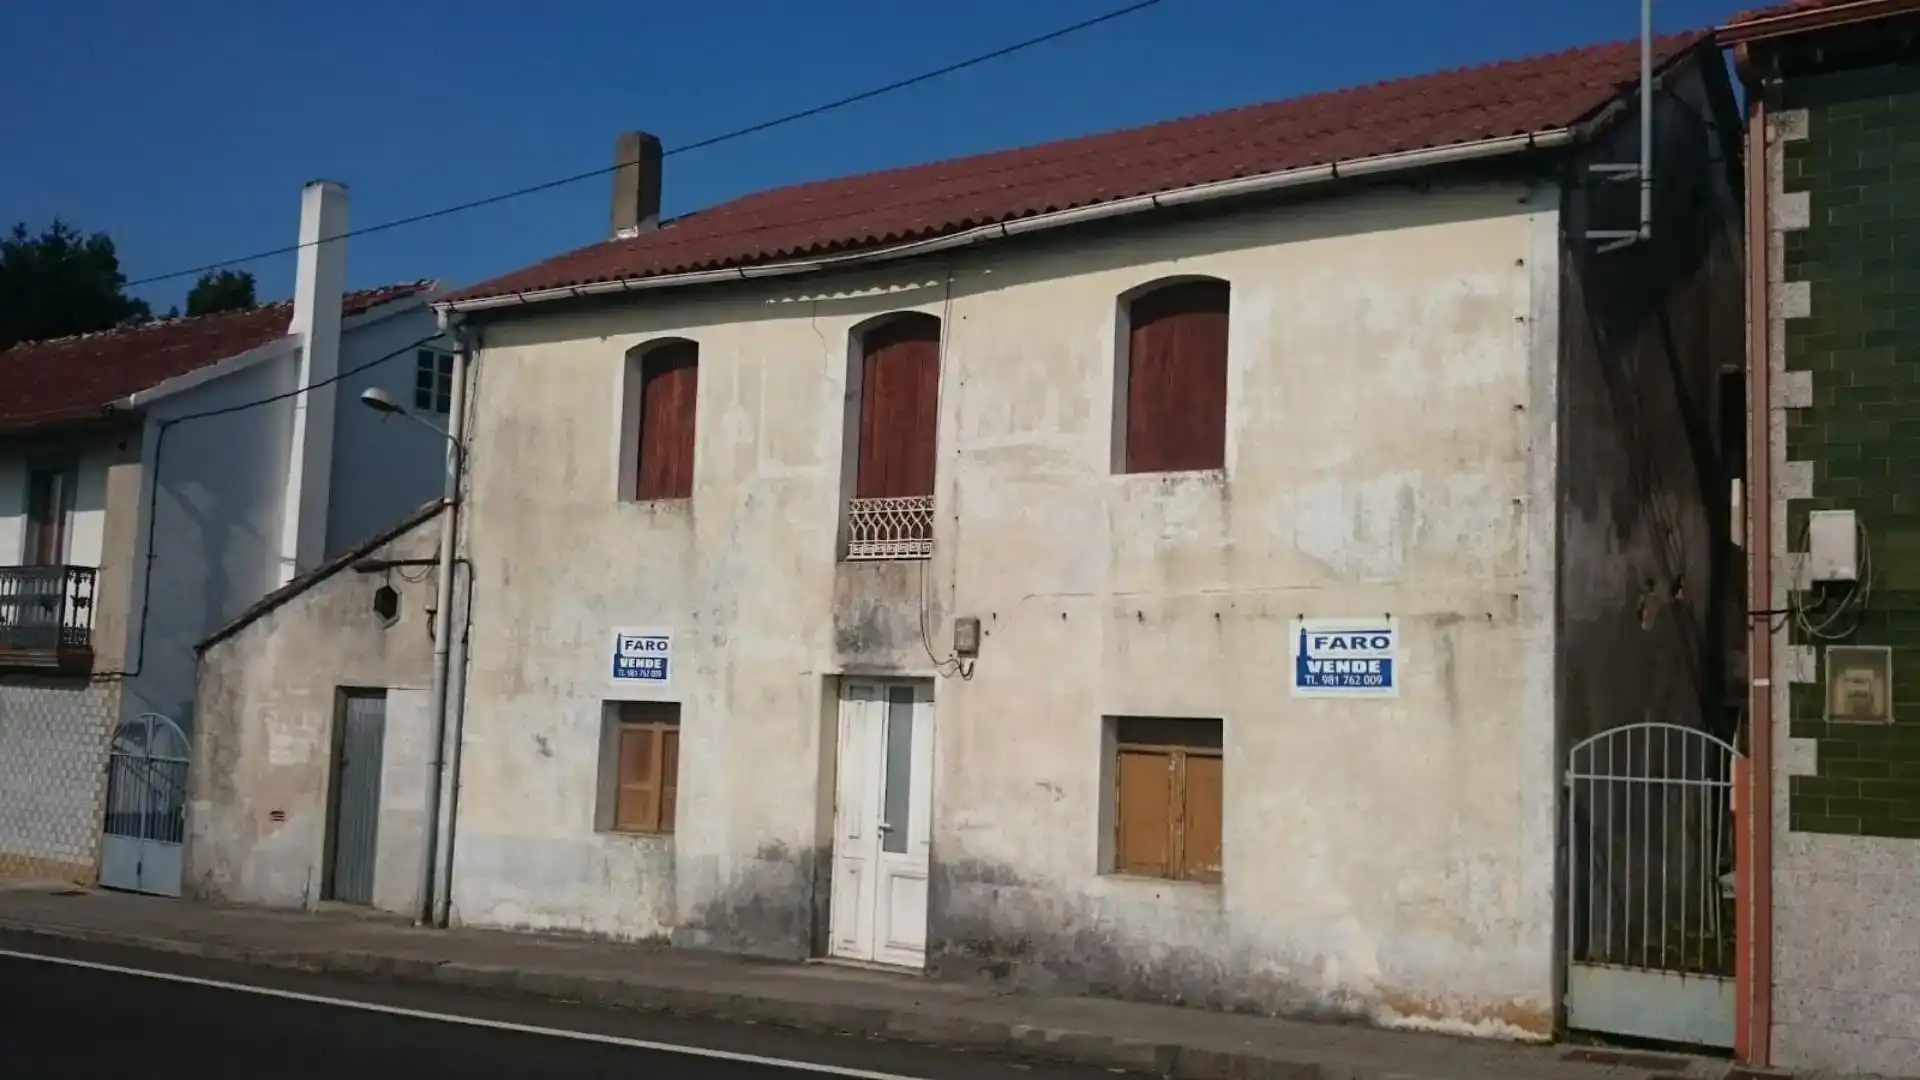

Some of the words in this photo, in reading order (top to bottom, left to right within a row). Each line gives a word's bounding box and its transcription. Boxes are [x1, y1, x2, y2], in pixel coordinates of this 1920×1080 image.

[625, 640, 668, 651] FARO
[1314, 636, 1390, 650] FARO
[620, 658, 662, 669] VENDE
[1306, 660, 1381, 673] VENDE
[1322, 675, 1339, 685] 981
[1343, 675, 1361, 685] 762
[1364, 675, 1383, 685] 009
